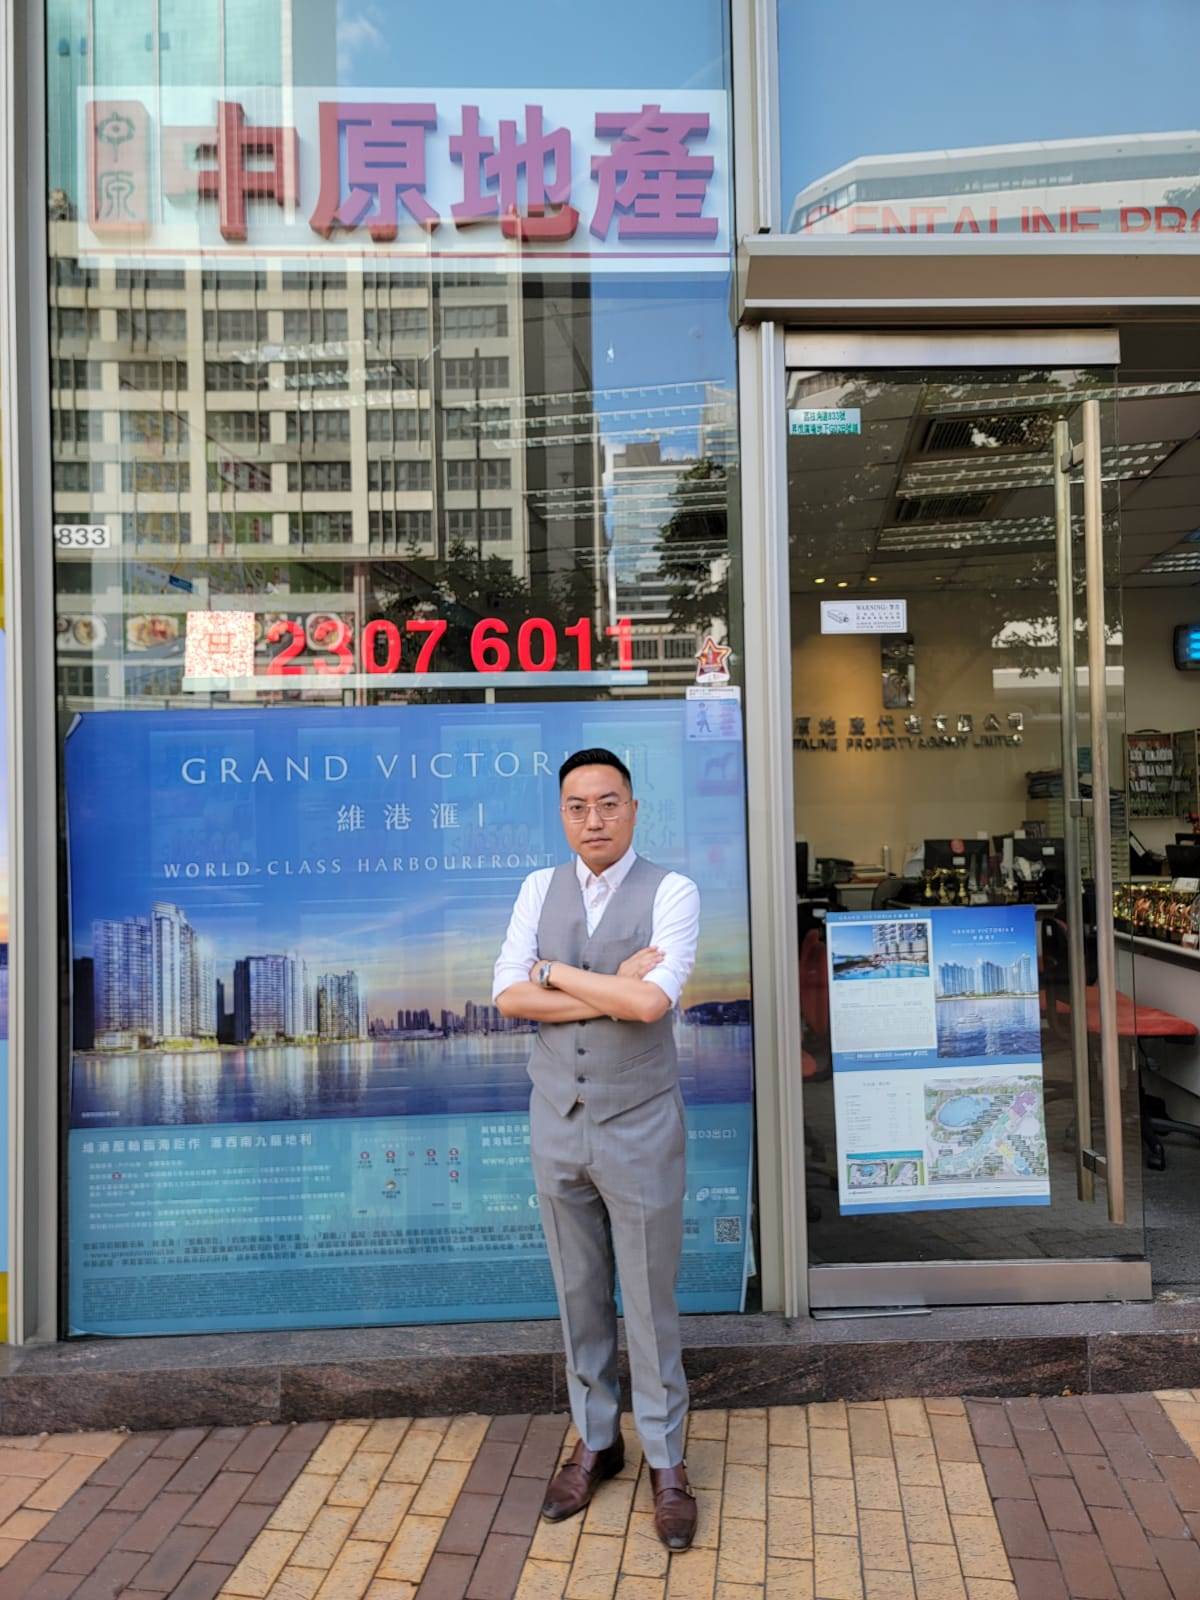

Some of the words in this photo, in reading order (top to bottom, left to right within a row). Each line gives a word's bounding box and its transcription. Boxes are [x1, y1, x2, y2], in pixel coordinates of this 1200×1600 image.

[164, 101, 719, 242] 中原地產
[58, 528, 106, 546] 833
[266, 620, 446, 676] 2307
[471, 617, 634, 673] 6011
[793, 735, 838, 751] TALINE
[846, 735, 914, 751] PROPERTY
[180, 755, 349, 785] GRAND
[375, 750, 568, 780] VICTOR
[163, 857, 343, 878] WORLD-CLASS
[358, 852, 554, 874] HARBOURFRONT
